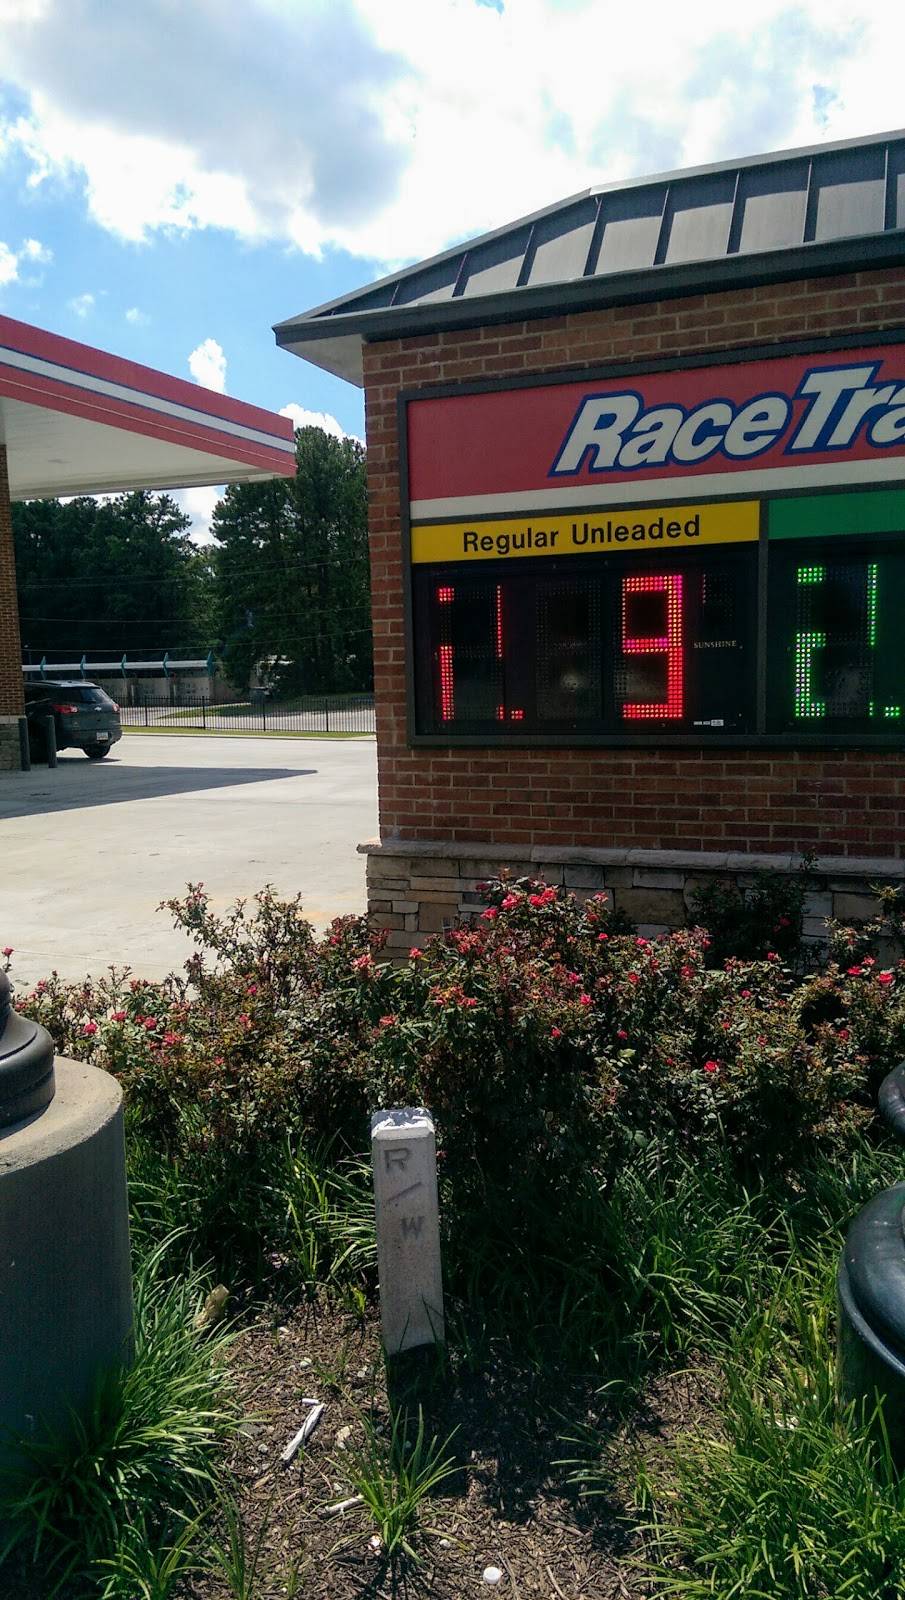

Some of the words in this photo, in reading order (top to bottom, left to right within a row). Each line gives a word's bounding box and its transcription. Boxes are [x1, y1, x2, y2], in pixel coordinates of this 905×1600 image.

[463, 527, 559, 555] Regular
[571, 514, 700, 545] Unleaded
[692, 640, 737, 649] SUNSHINE
[383, 1147, 410, 1172] R
[400, 1215, 425, 1240] W
